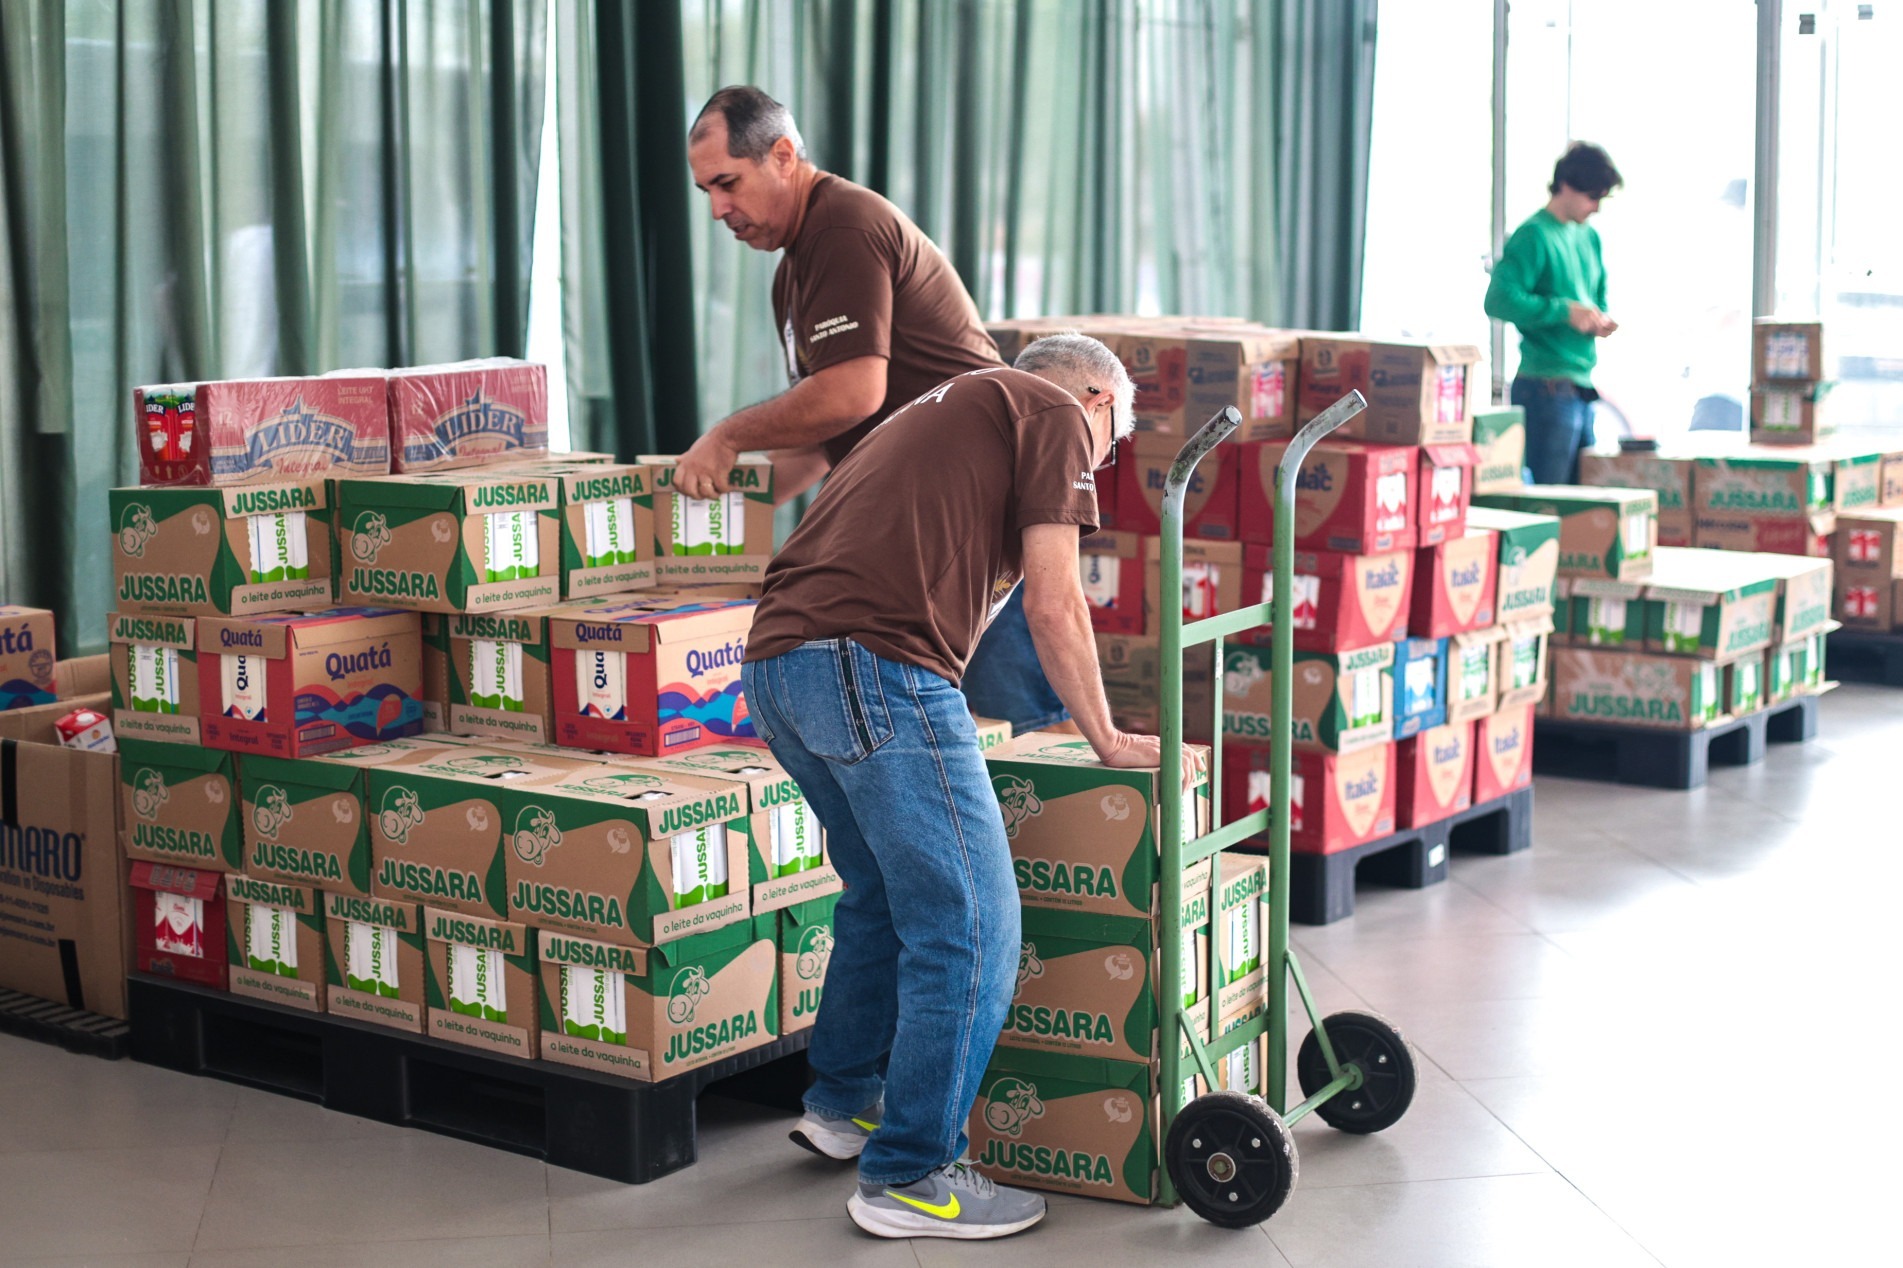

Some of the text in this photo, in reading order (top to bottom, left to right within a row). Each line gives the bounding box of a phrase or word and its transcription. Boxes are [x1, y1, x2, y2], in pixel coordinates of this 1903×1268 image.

[145, 403, 164, 414] IDER
[231, 486, 317, 515] JUSSARA
[472, 483, 550, 508] JUSSARA
[571, 474, 644, 502] JUSSARA
[348, 568, 439, 600] JUSSARA
[584, 575, 602, 586] leite
[603, 572, 614, 584] da
[614, 570, 650, 584] vaquinha
[665, 563, 689, 574] leite
[691, 563, 706, 574] da
[708, 563, 759, 576] vaquinha
[120, 574, 209, 603] JUSSARA
[241, 585, 325, 603] o leite da vaquinha
[475, 586, 552, 604] o leite da vaquinha
[116, 618, 187, 644] JUSSARA
[220, 627, 263, 648] Quatá
[454, 616, 532, 640] JUSSARA
[575, 622, 622, 643] Quatá
[236, 655, 249, 691] Qua
[325, 642, 392, 681] Quatá
[594, 651, 607, 689] Qua
[686, 637, 745, 679] Quatá
[1568, 693, 1682, 721] JUSSARA
[465, 714, 484, 725] leite
[486, 715, 497, 726] da
[498, 718, 537, 733] vaquinha
[759, 780, 802, 808] JUSS
[658, 791, 741, 834] JUSSARA
[132, 823, 216, 858] JUSSARA
[252, 842, 343, 881] JUSSARA
[232, 878, 305, 909] JUSSARA
[378, 858, 483, 903] JUSSARA
[768, 886, 787, 899] leite
[788, 883, 799, 895] da
[800, 873, 836, 891] vaquinha
[1014, 859, 1117, 899] SSARA
[1221, 867, 1267, 911] JUSSARA
[330, 895, 407, 929] JUSSARA
[511, 880, 624, 928] JUSSARA
[663, 901, 743, 934] o leite da vaquinha
[431, 917, 515, 952] JUSSARA
[545, 938, 636, 973] JUSSARA
[444, 1019, 464, 1033] leite
[466, 1025, 477, 1036] da
[478, 1028, 521, 1047] vaquinha
[663, 1010, 757, 1064] JUSSARA
[550, 1041, 641, 1070] o leite da vaquinha
[979, 1139, 1113, 1184] JUSSARA
